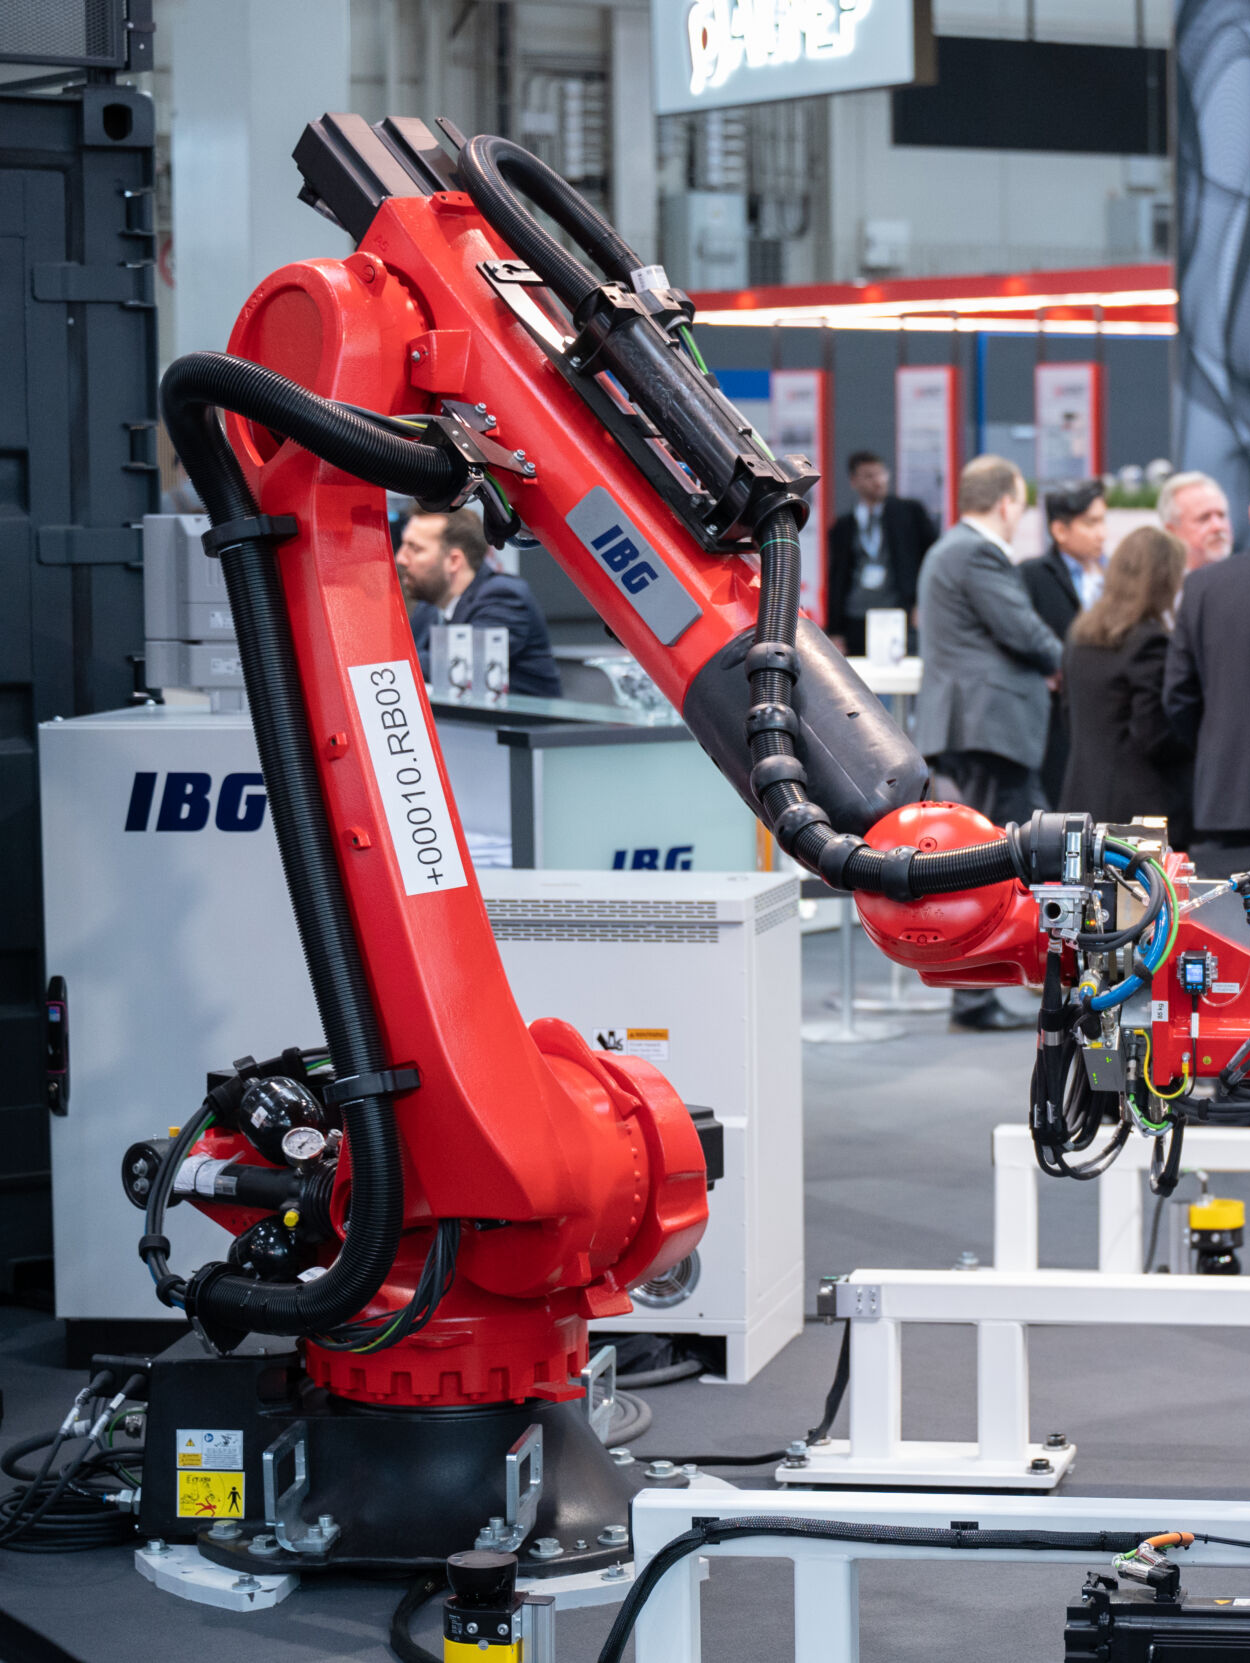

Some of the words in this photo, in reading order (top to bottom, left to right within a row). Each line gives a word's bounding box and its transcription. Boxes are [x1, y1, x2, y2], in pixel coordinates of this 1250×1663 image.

[591, 524, 659, 595] IBG
[125, 772, 267, 832] IBG
[370, 668, 443, 885] +00010.RB03
[612, 846, 694, 870] IBG
